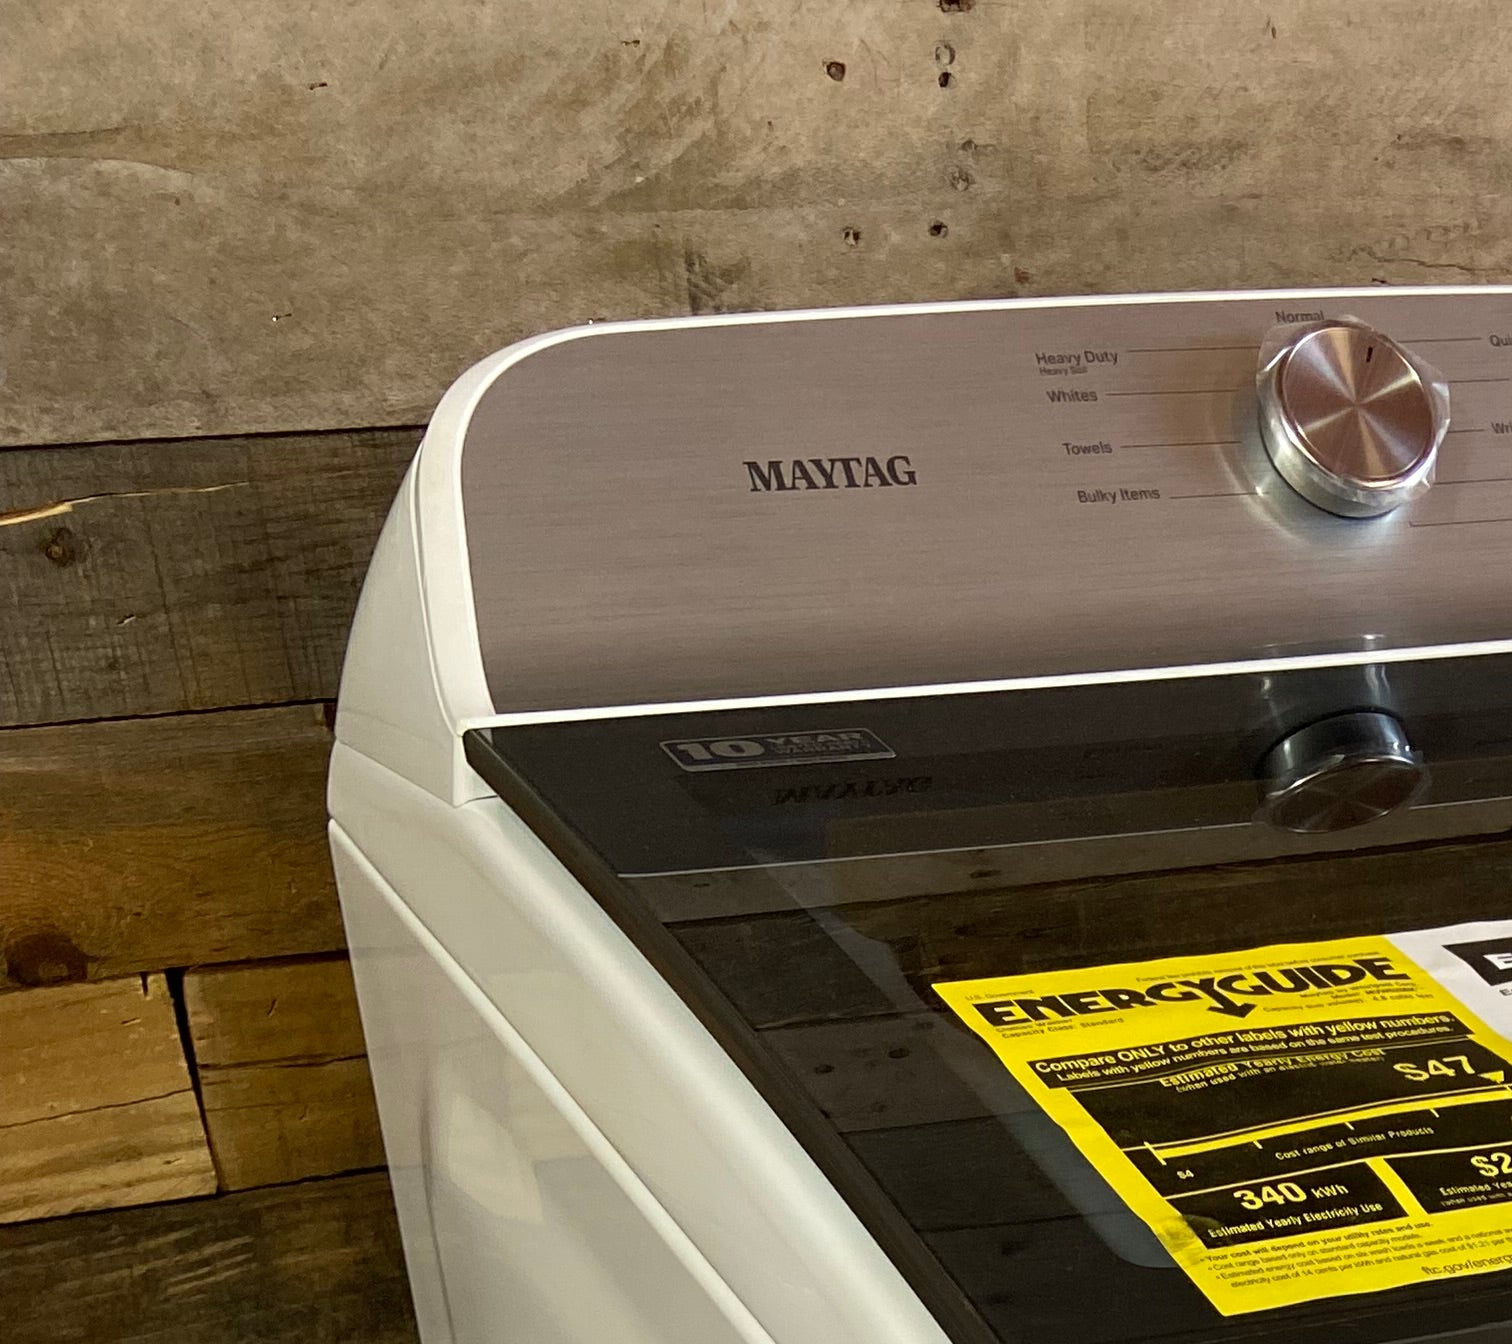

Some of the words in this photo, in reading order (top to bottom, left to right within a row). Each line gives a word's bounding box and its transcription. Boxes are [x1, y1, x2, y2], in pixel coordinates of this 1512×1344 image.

[1276, 310, 1324, 323] Normal
[1036, 352, 1081, 365] Heavy
[1084, 351, 1118, 364] Duty
[1046, 390, 1098, 402] Whites
[1062, 442, 1112, 455] Towels
[744, 456, 918, 492] MAYTAG
[1078, 490, 1116, 504] Bulky
[1120, 488, 1160, 501] Items
[677, 740, 764, 760] 10
[765, 732, 863, 745] YEAR
[972, 957, 1411, 1026] ENERGYGUIDE
[1036, 1056, 1115, 1074] Compare
[1118, 1044, 1166, 1062] ONLY
[1169, 1041, 1188, 1053] to
[1192, 1033, 1234, 1047] other
[1236, 1023, 1287, 1041] labels
[1288, 1023, 1324, 1037] with
[1325, 1020, 1379, 1039] yellow
[1380, 1012, 1454, 1029] numbers.
[1057, 1070, 1100, 1082] Labels
[1102, 1066, 1130, 1077] with
[1130, 1056, 1170, 1074] yellow
[1174, 1049, 1226, 1064] numbers
[1229, 1043, 1249, 1054] are
[1251, 1038, 1288, 1052] based
[1290, 1039, 1305, 1048] on
[1306, 1036, 1326, 1047] the
[1328, 1033, 1358, 1044] same
[1360, 1030, 1384, 1041] test
[1385, 1024, 1454, 1041] procedures.
[1160, 1064, 1239, 1088] Estimated
[1237, 1055, 1293, 1073] Yearly
[1290, 1050, 1349, 1063] Energy
[1350, 1048, 1386, 1057] Cost
[1393, 1055, 1476, 1081] $47
[1275, 1150, 1300, 1160] Cost
[1303, 1142, 1334, 1155] range
[1336, 1140, 1347, 1148] of
[1348, 1133, 1386, 1146] Similar
[1388, 1127, 1434, 1140] Products
[1176, 1169, 1194, 1180] $4
[1234, 1182, 1307, 1210] 340
[1311, 1183, 1349, 1199] kWh
[1440, 1184, 1491, 1196] Estimated
[1208, 1221, 1264, 1239] Estimated
[1266, 1215, 1302, 1230] Yearly
[1303, 1206, 1359, 1222] Electricity
[1360, 1202, 1383, 1213] Use
